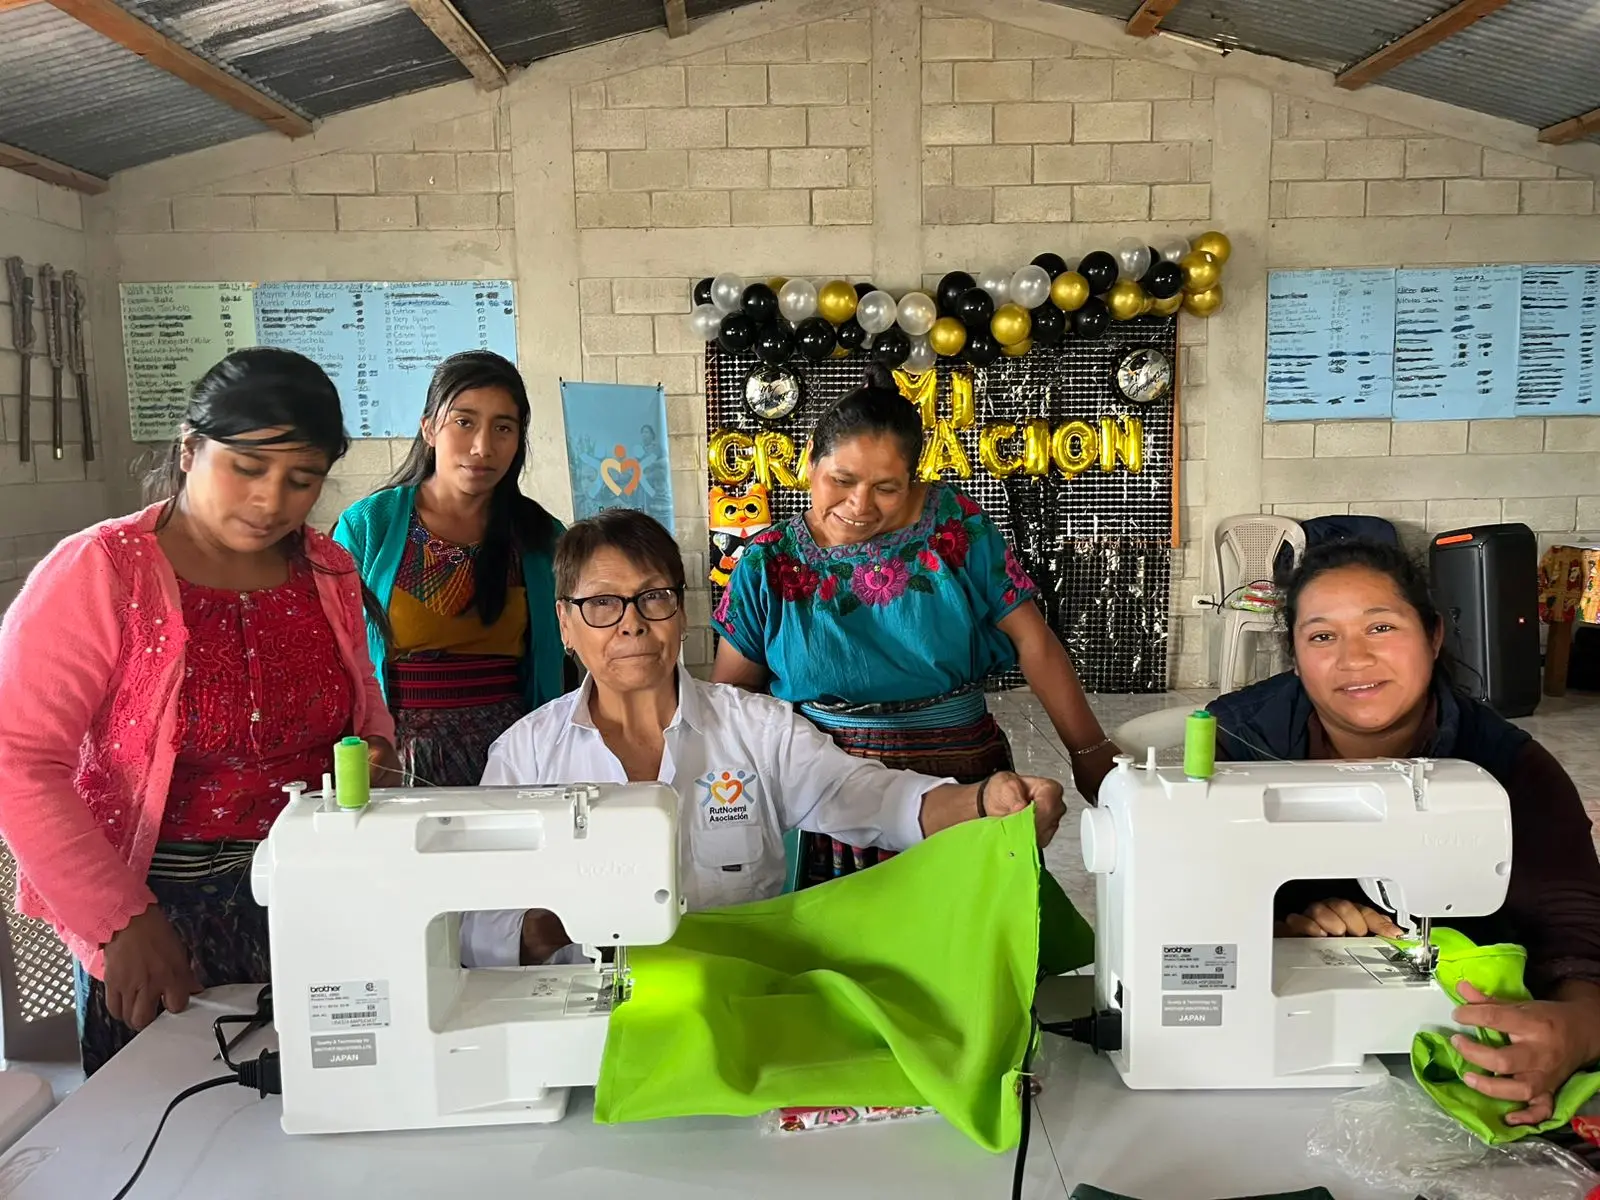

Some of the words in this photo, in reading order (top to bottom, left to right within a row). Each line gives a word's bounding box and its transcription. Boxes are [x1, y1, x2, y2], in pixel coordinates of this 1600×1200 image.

[708, 413, 1144, 491] GRACION
[709, 805, 747, 815] RutNoemi
[709, 814, 749, 822] Asociación
[1163, 946, 1193, 954] brother
[310, 985, 341, 993] brother
[1178, 1014, 1206, 1022] JAPAN
[330, 1054, 359, 1063] JAPAN
